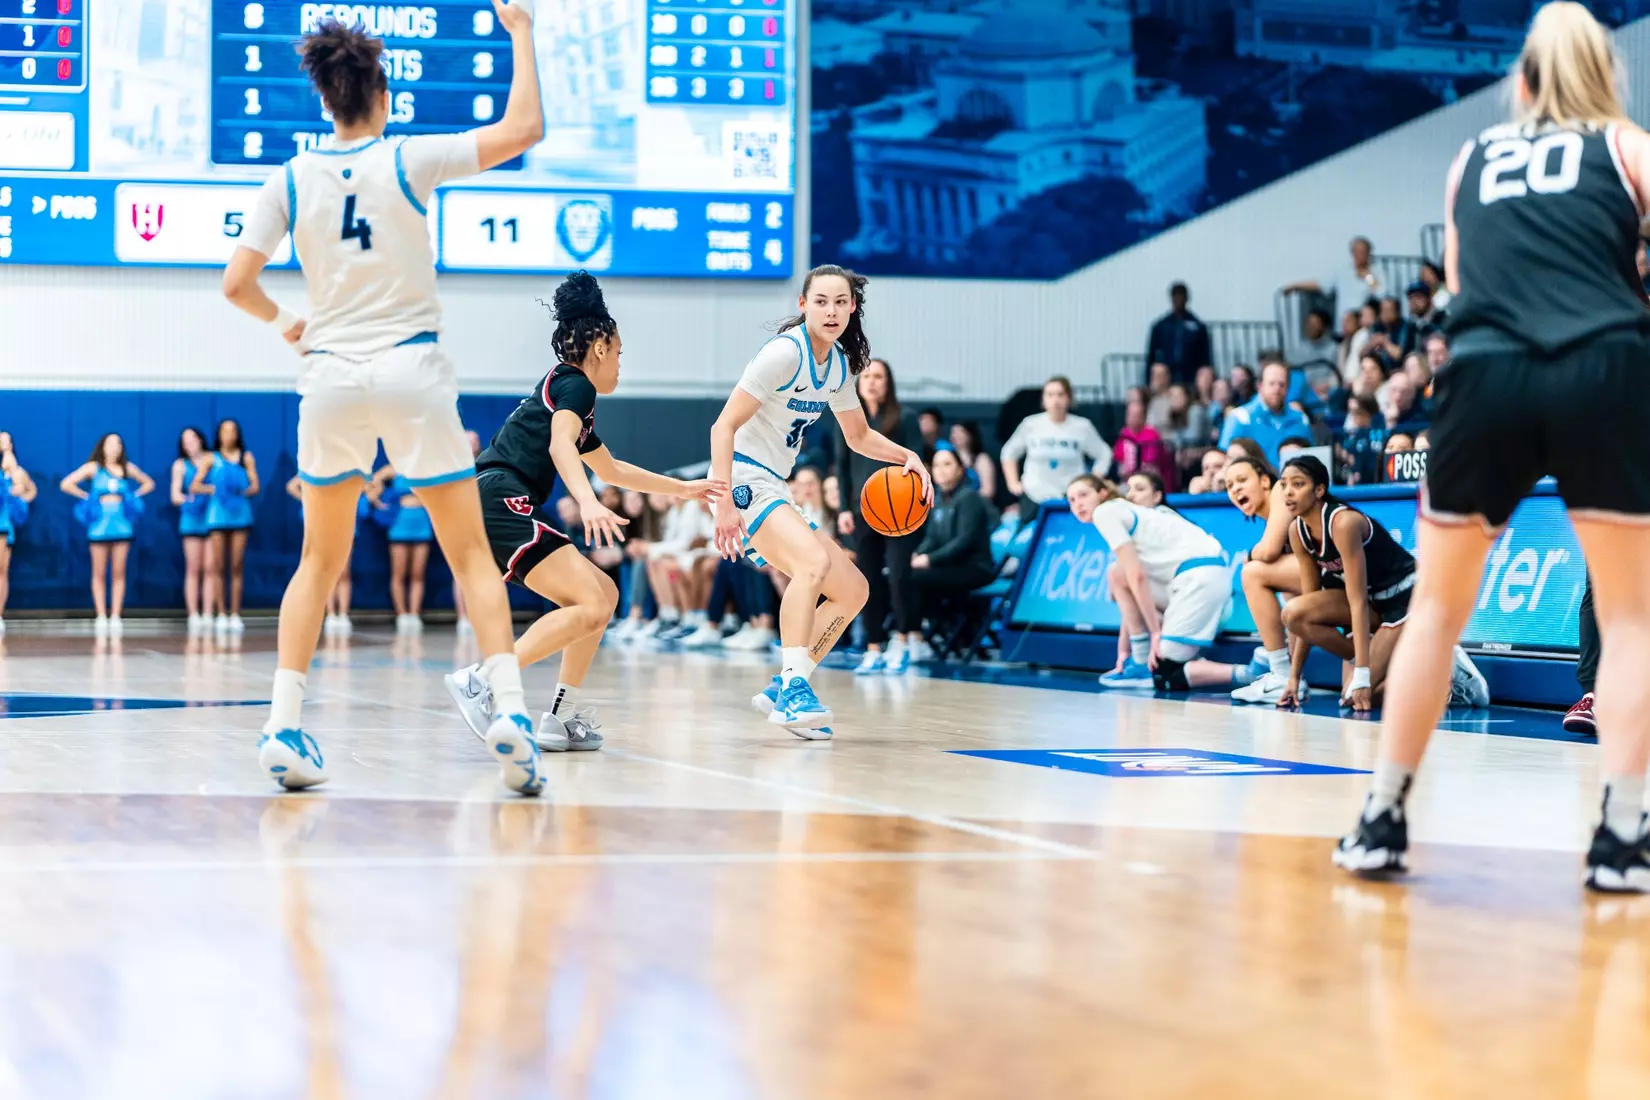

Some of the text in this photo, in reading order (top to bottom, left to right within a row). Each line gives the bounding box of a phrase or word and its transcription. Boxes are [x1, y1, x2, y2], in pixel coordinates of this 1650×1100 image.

[23, 25, 72, 47] 1 0
[22, 57, 72, 80] 0 0
[245, 45, 262, 71] 1
[244, 88, 261, 114] 1
[1479, 131, 1584, 206] 20
[224, 212, 244, 238] 5
[341, 194, 371, 250] 4
[765, 201, 782, 229] 2
[480, 217, 517, 242] 11
[1394, 451, 1427, 480] POSS
